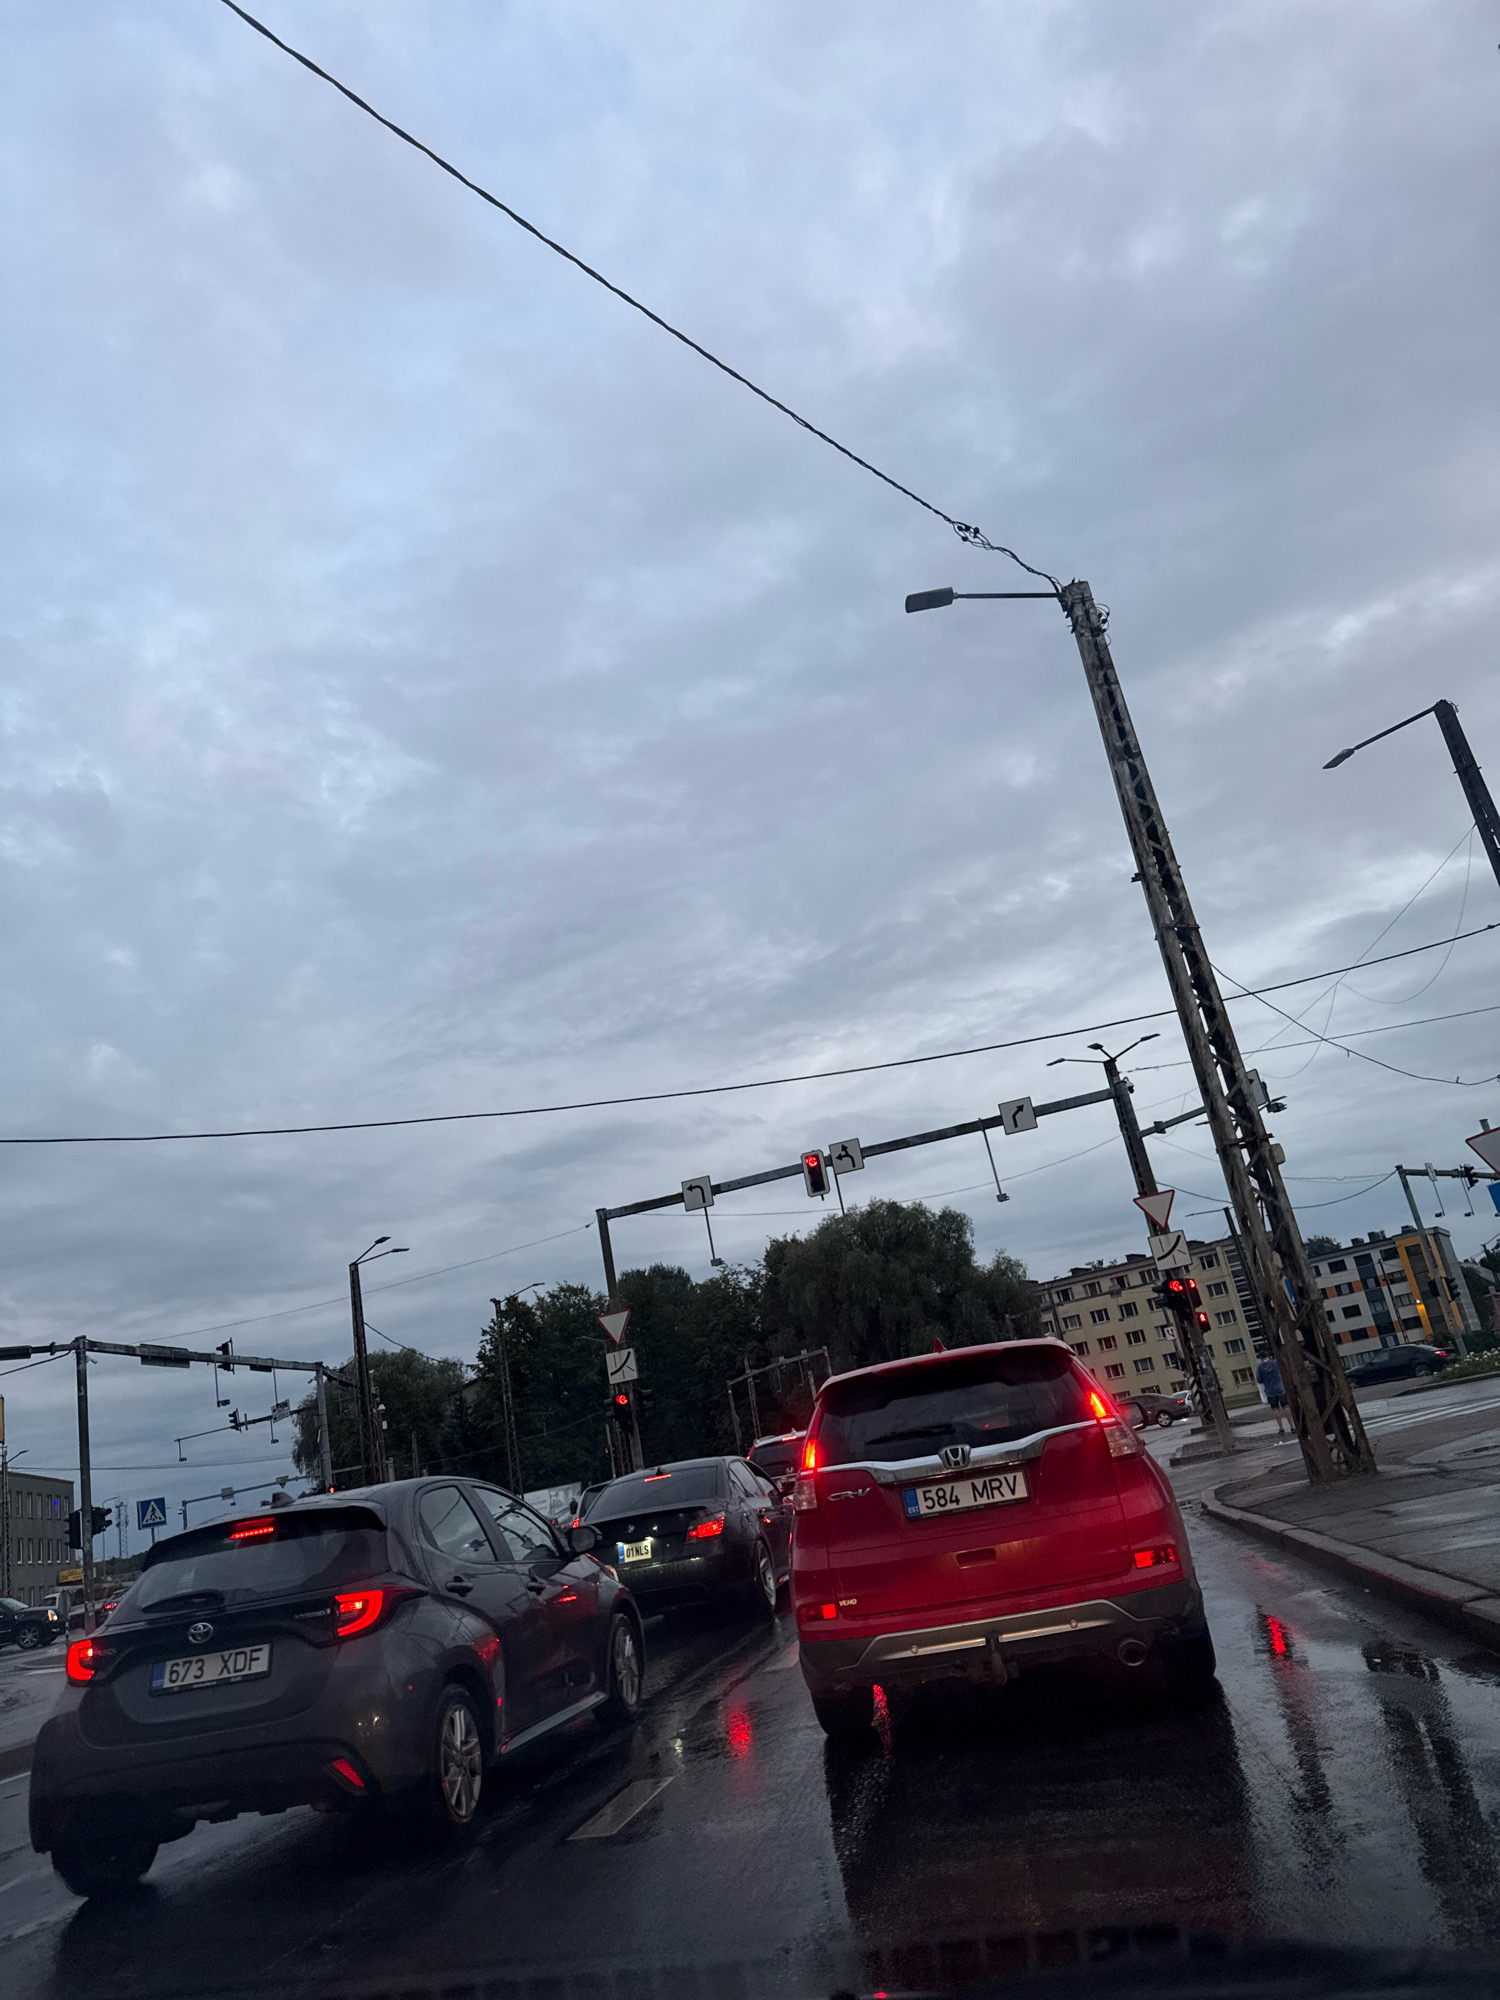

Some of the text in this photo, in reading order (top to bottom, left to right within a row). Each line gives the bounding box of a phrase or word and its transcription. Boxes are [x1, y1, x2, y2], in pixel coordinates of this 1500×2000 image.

[827, 1487, 871, 1501] CR-V
[923, 1476, 1017, 1510] 584 MRV
[907, 1506, 919, 1514] EST
[168, 1648, 263, 1684] 673 XDF
